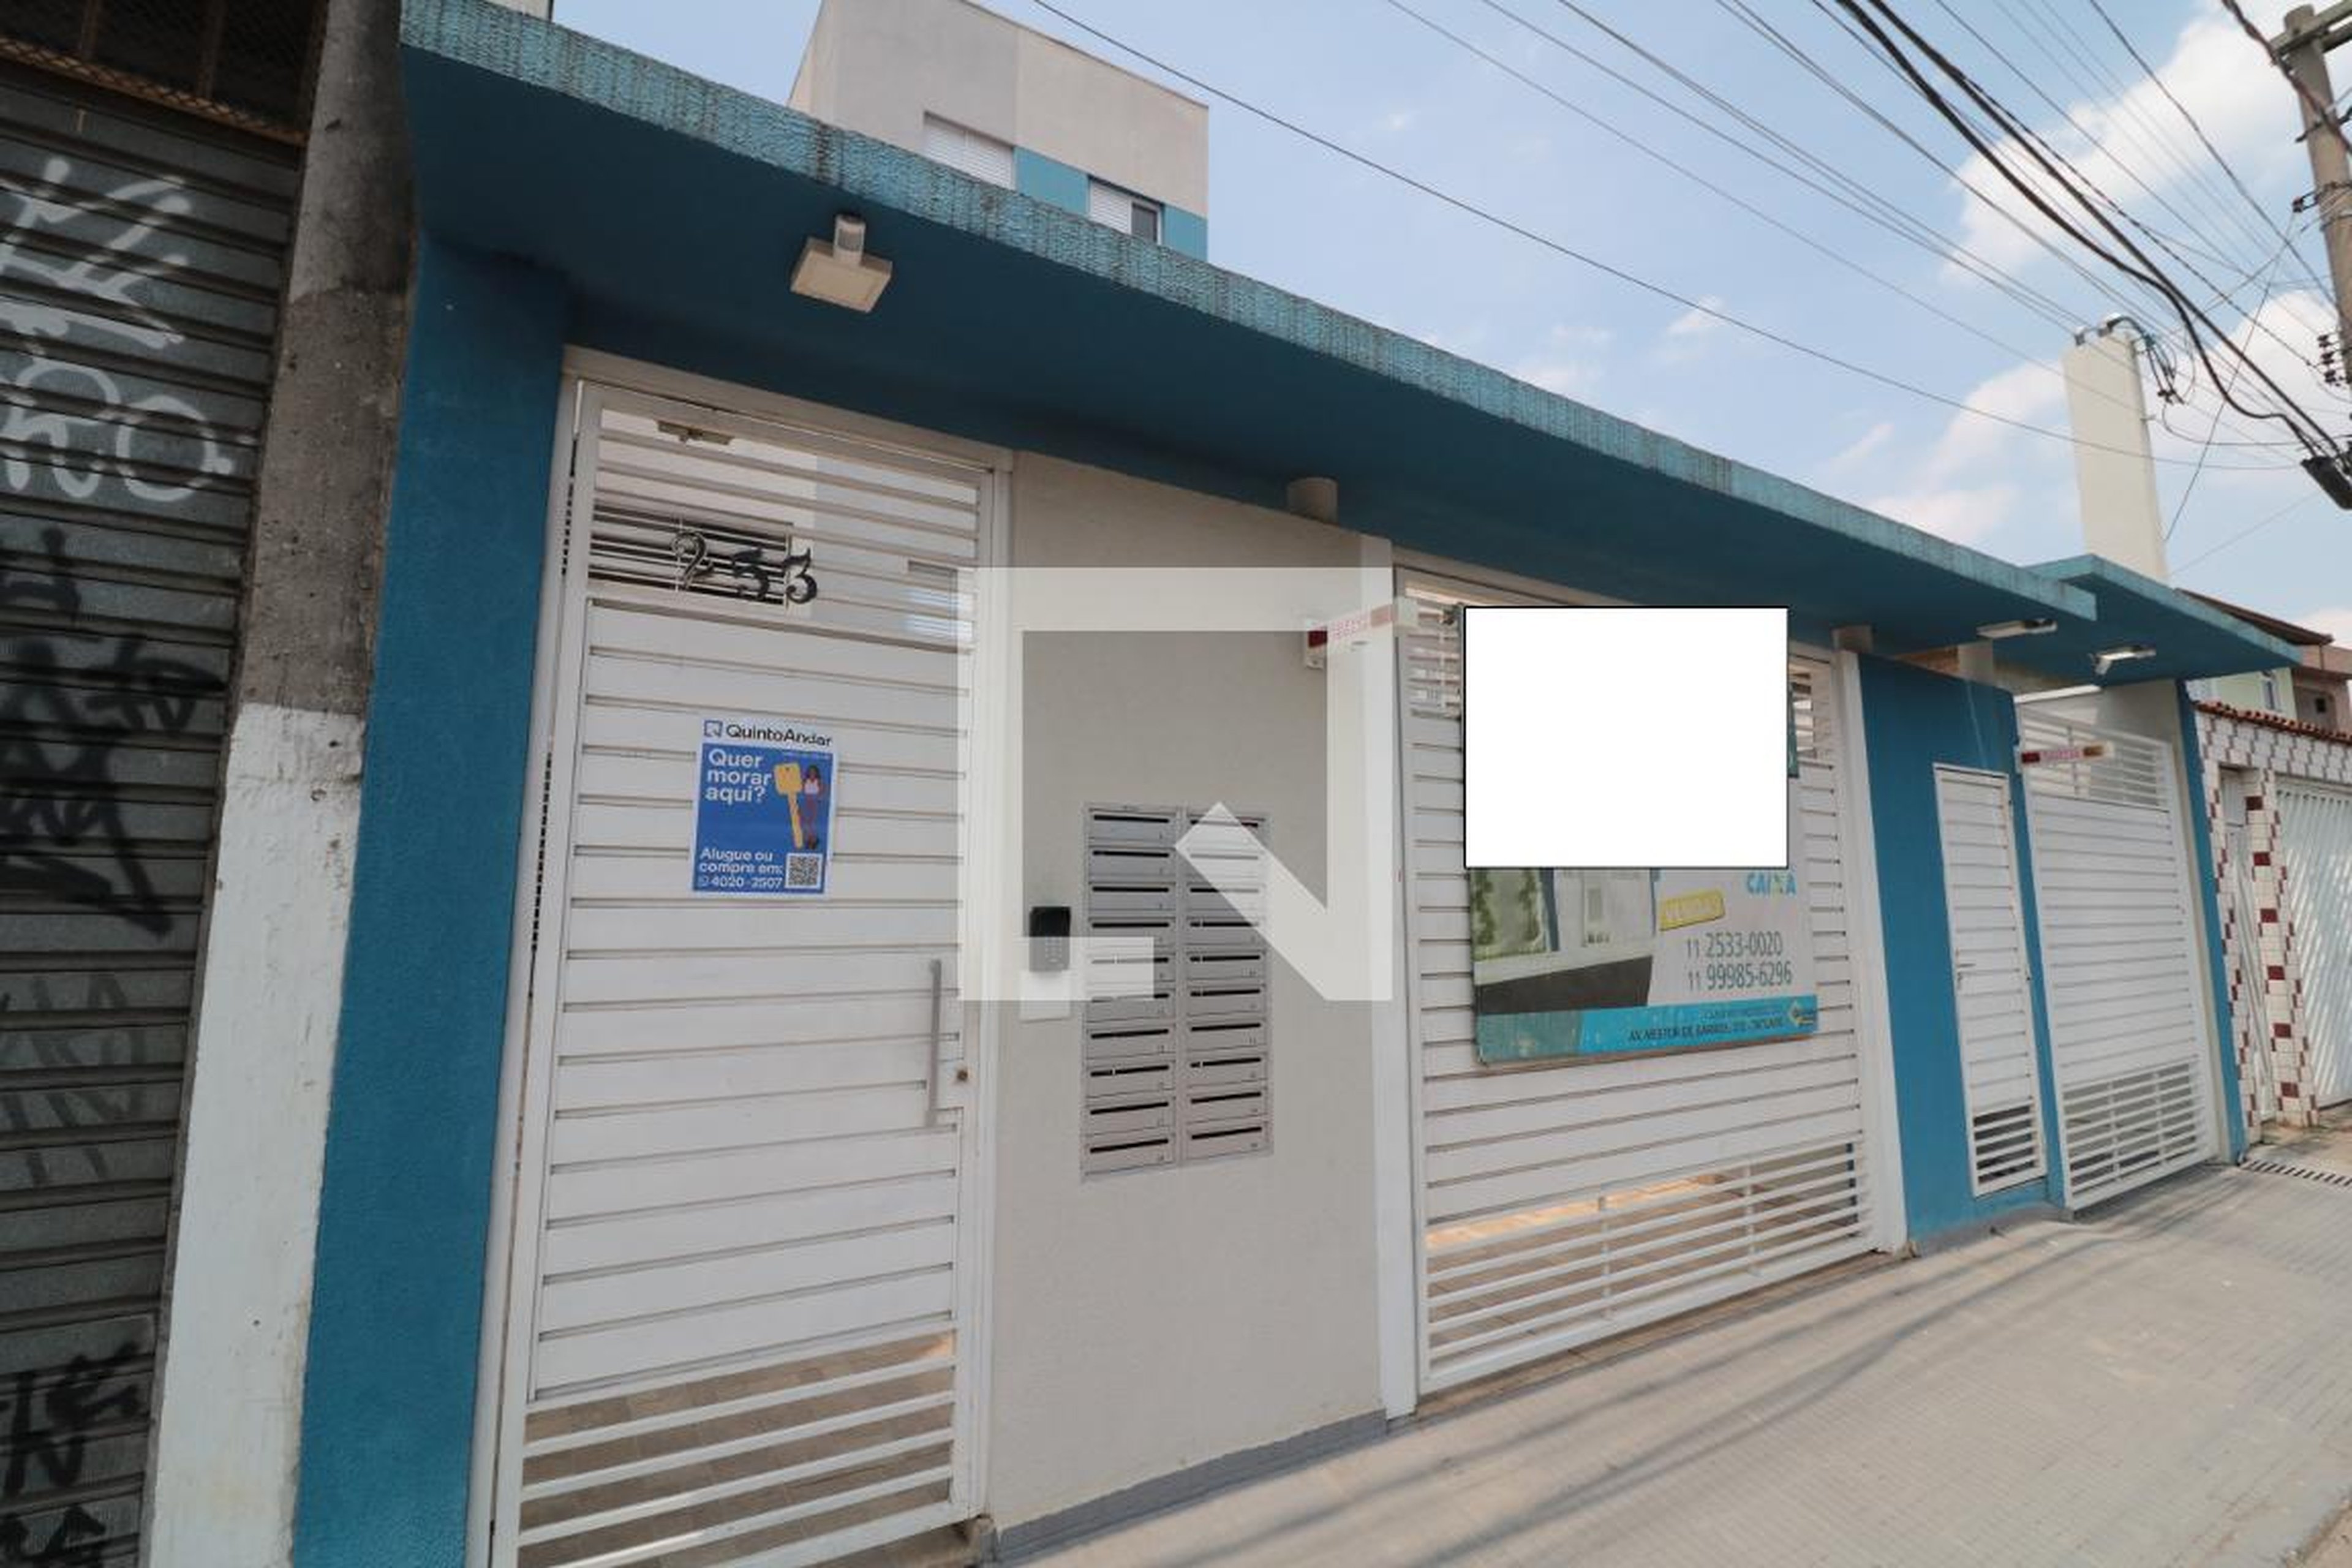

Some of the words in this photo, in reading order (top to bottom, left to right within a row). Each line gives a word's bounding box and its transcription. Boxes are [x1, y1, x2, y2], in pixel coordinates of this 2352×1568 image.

[726, 723, 832, 747] QuintoAndar
[708, 748, 763, 768] Quer
[706, 769, 772, 786] morar
[705, 785, 766, 805] aqui?
[700, 847, 752, 863] Alugue
[754, 851, 773, 862] ou
[699, 861, 755, 875] compra
[1747, 873, 1796, 895] CAIXA
[1705, 930, 1784, 958] 2533-0020
[1706, 960, 1792, 990] 99985-6296
